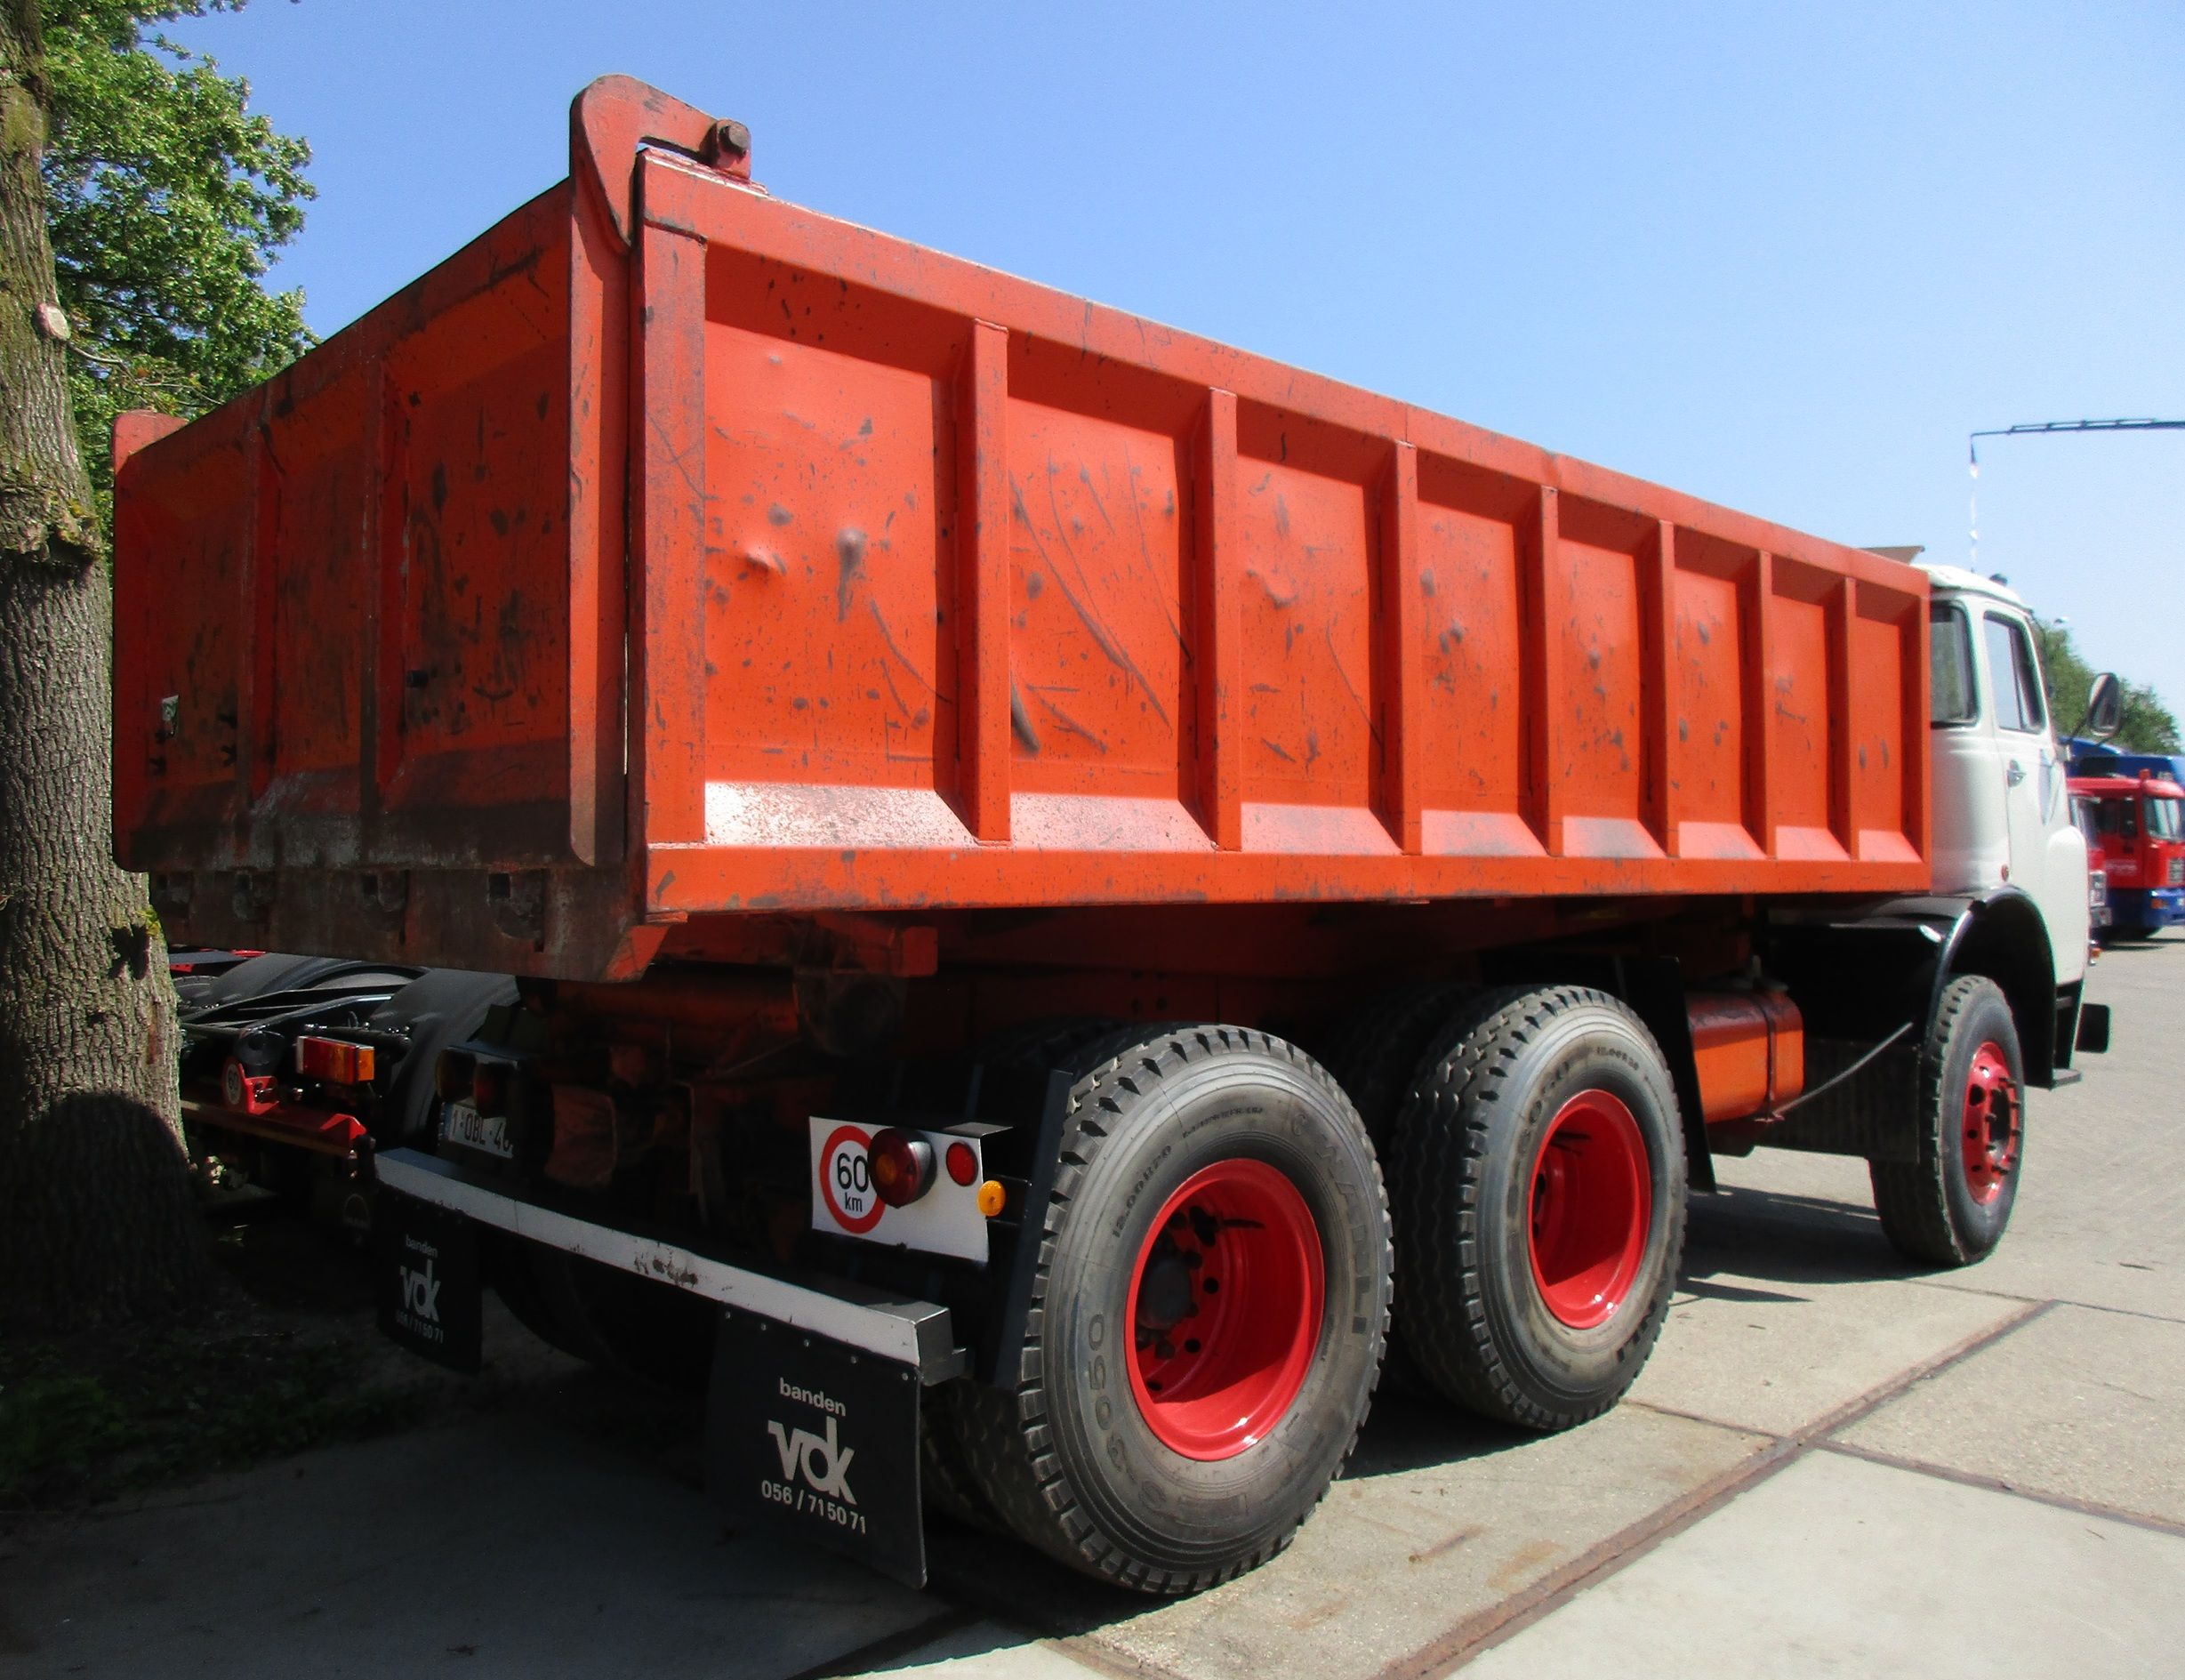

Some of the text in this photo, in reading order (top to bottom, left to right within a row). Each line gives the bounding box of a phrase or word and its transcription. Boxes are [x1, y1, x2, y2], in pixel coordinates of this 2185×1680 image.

[837, 1153, 869, 1193] 60
[845, 1193, 863, 1212] km
[400, 1258, 441, 1322] vdk
[780, 1378, 846, 1416] banden
[767, 1416, 857, 1505] vdk
[761, 1480, 793, 1506] 056
